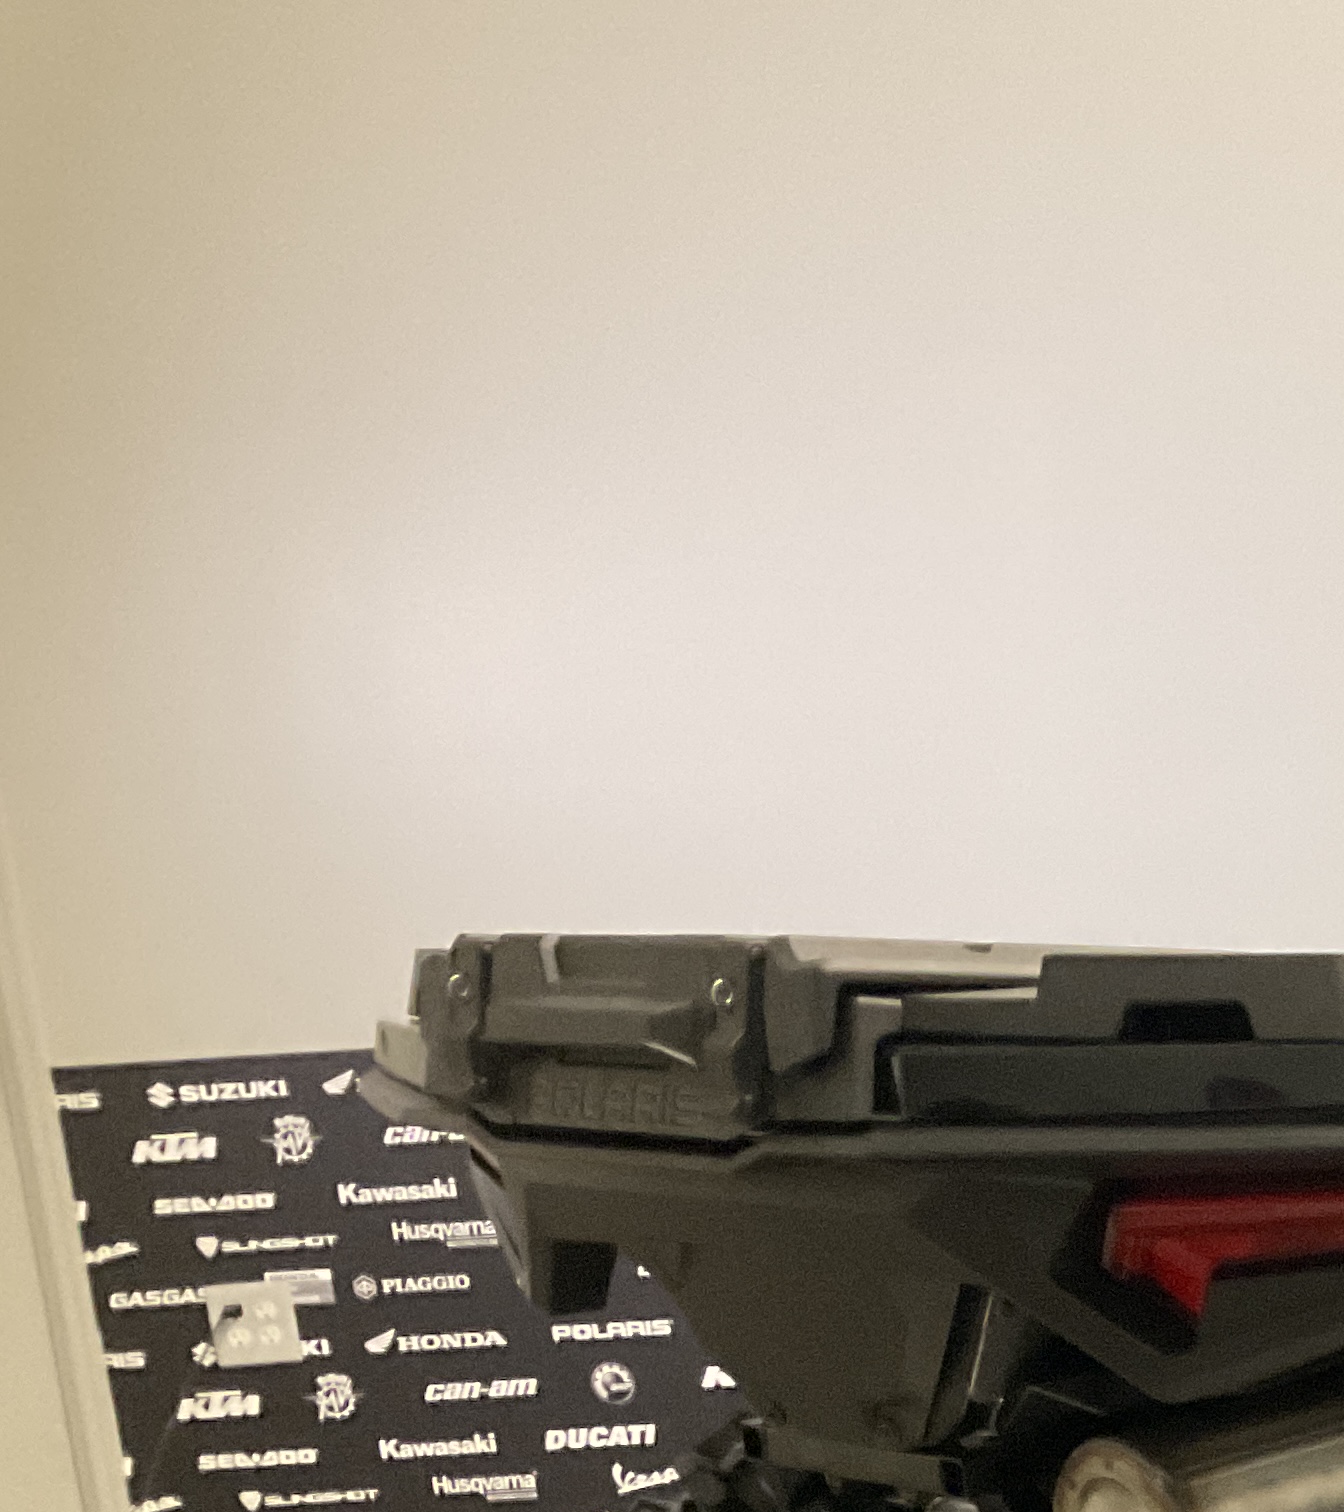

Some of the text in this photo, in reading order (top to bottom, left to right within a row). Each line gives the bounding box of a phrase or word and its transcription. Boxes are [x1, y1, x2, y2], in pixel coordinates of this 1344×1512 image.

[179, 1079, 289, 1102] SUZUKI
[132, 1132, 217, 1164] KTM
[338, 1177, 457, 1204] Kawasaki
[381, 1274, 470, 1294] PIAGGIO
[397, 1331, 507, 1352] HONDA
[551, 1319, 673, 1342] POLARIS
[425, 1378, 537, 1402] can-am
[177, 1390, 260, 1421] KTM
[379, 1433, 497, 1459] Kawasaki
[545, 1424, 655, 1451] DUCATI
